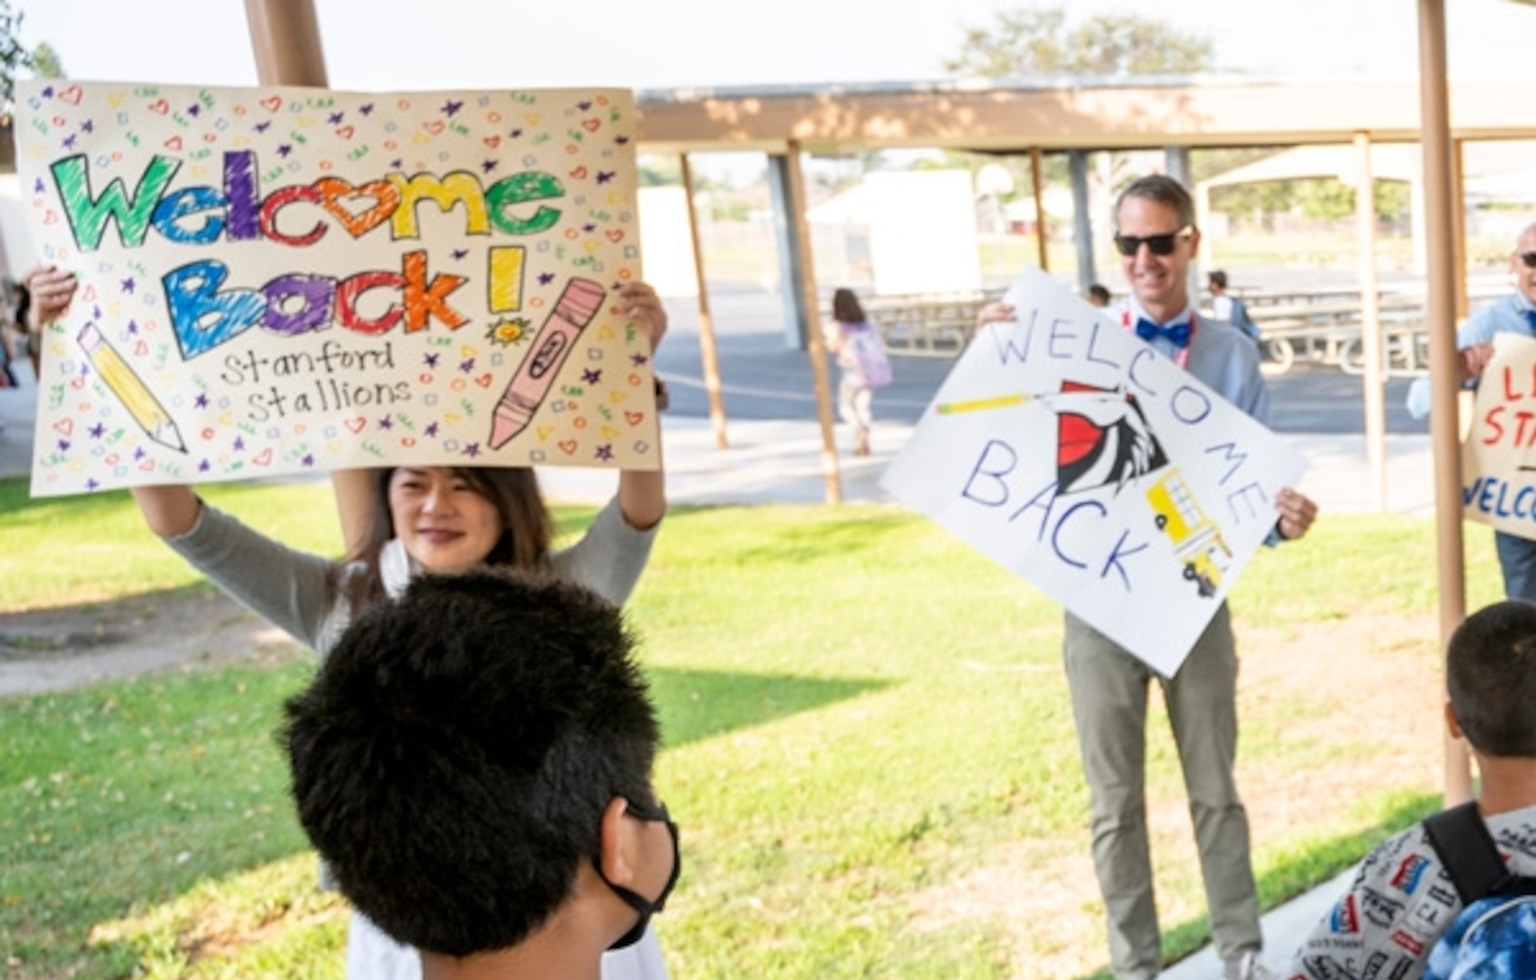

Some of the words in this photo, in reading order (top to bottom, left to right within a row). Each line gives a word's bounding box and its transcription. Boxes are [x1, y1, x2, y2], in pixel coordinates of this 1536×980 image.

[50, 150, 566, 252] Welcome
[160, 245, 526, 361] Back!
[220, 340, 396, 386] Stanford
[248, 378, 412, 425] Stallions
[995, 310, 1270, 526] WELCOME
[962, 440, 1150, 592] BACK
